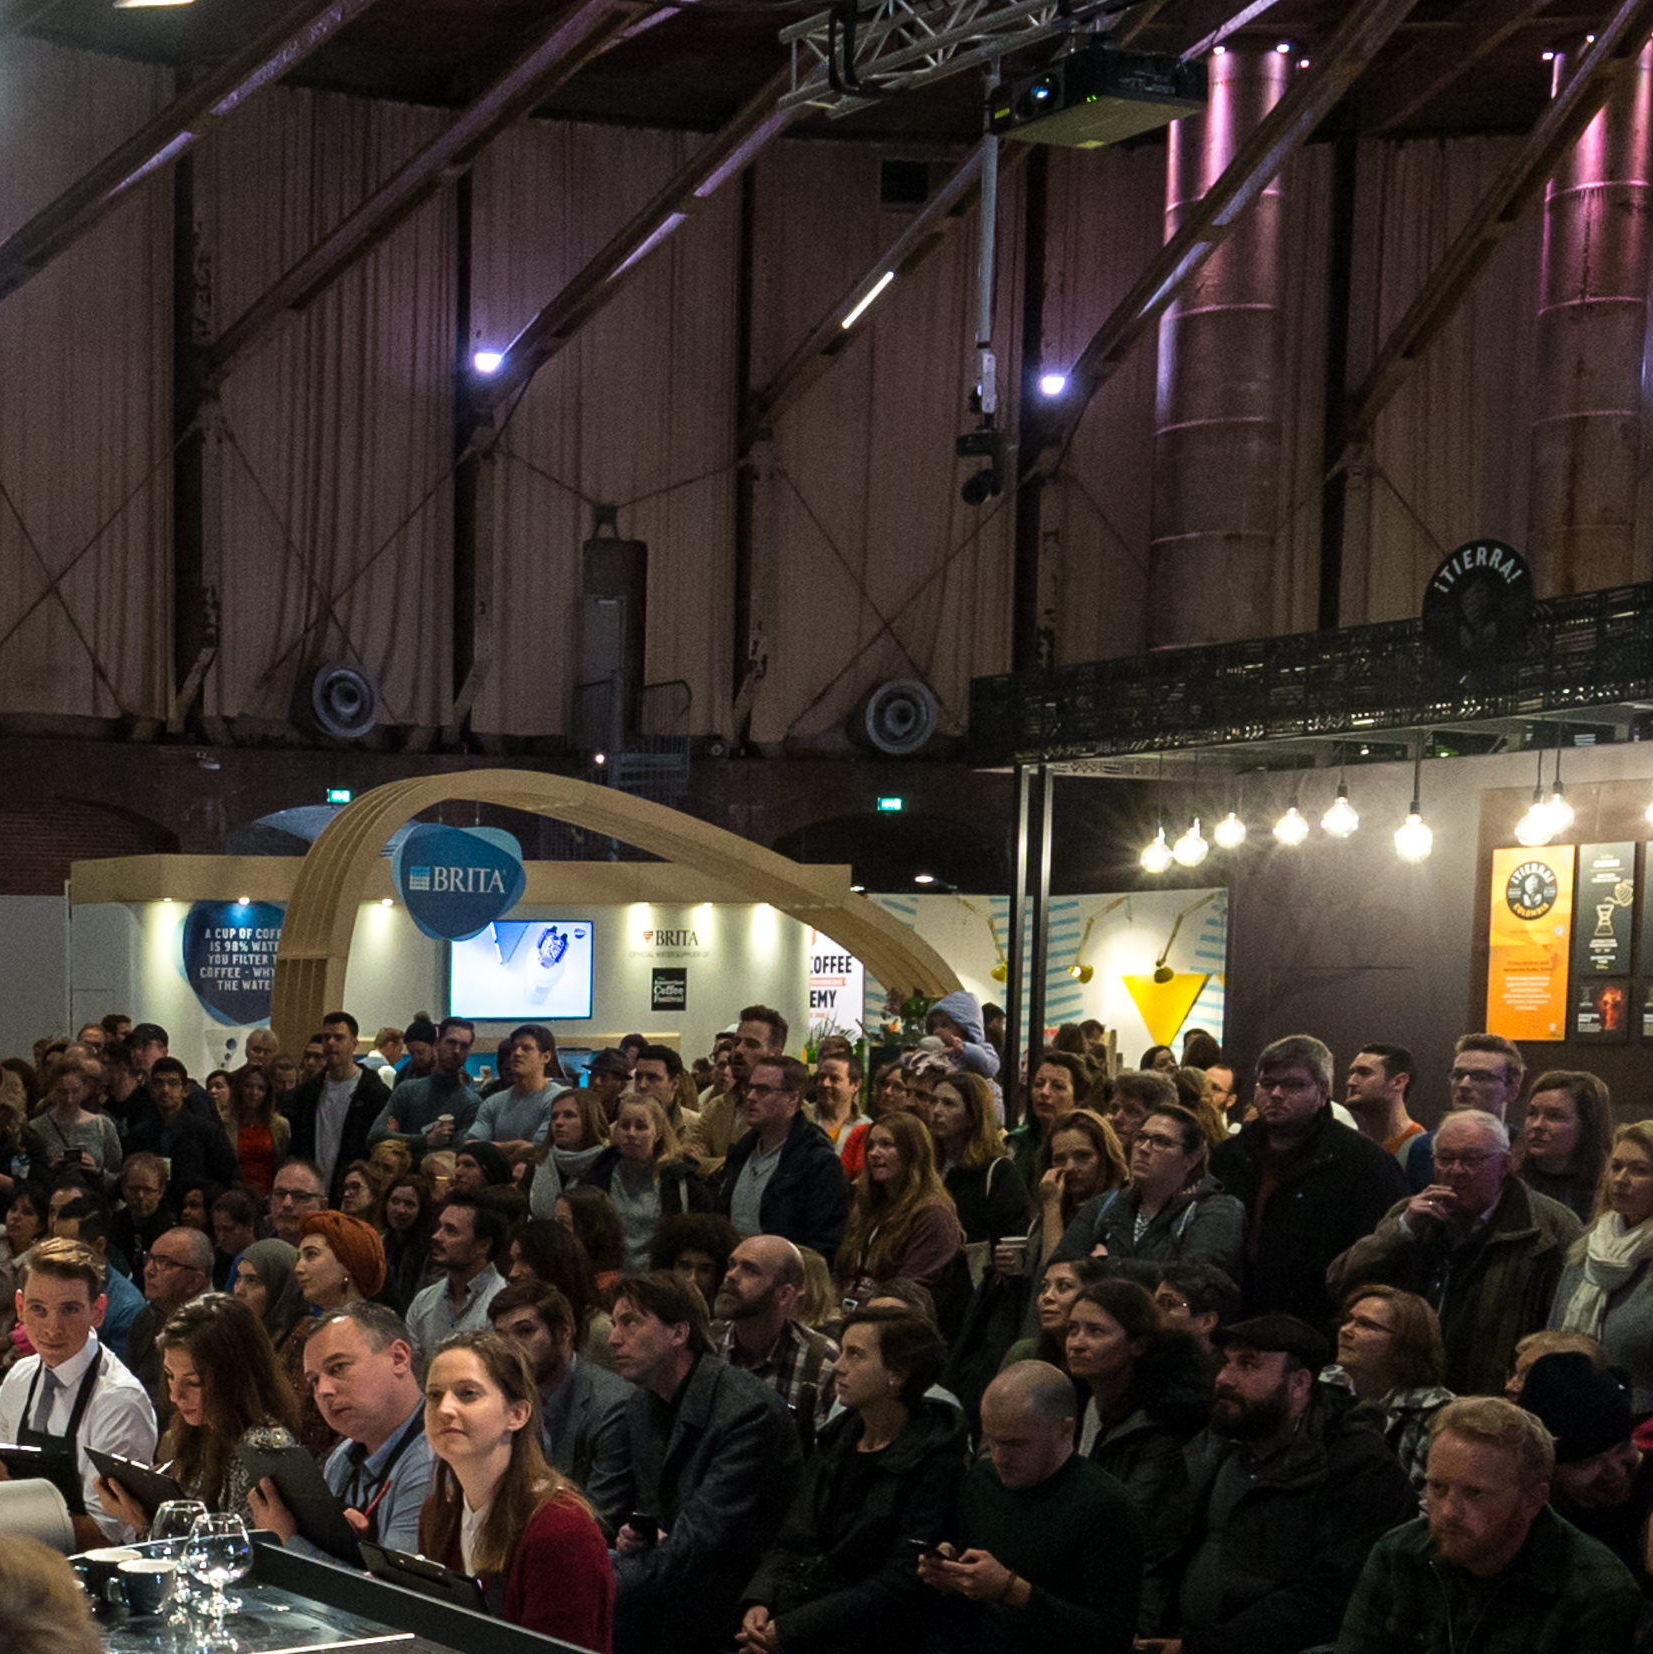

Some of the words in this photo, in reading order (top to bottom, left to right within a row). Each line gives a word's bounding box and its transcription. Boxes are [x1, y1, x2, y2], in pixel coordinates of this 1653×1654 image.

[433, 866, 505, 893] BRITA
[205, 928, 211, 939] A
[215, 928, 236, 939] CUP
[239, 928, 253, 939] OF
[256, 928, 282, 939] COFF
[656, 929, 698, 946] BRITA
[210, 941, 220, 952] IS
[207, 953, 227, 965] YOU
[232, 953, 268, 965] FILTER
[811, 955, 852, 974] OFFEE
[200, 967, 241, 978] COFFEE
[217, 980, 238, 991] THE
[242, 980, 274, 991] WATE
